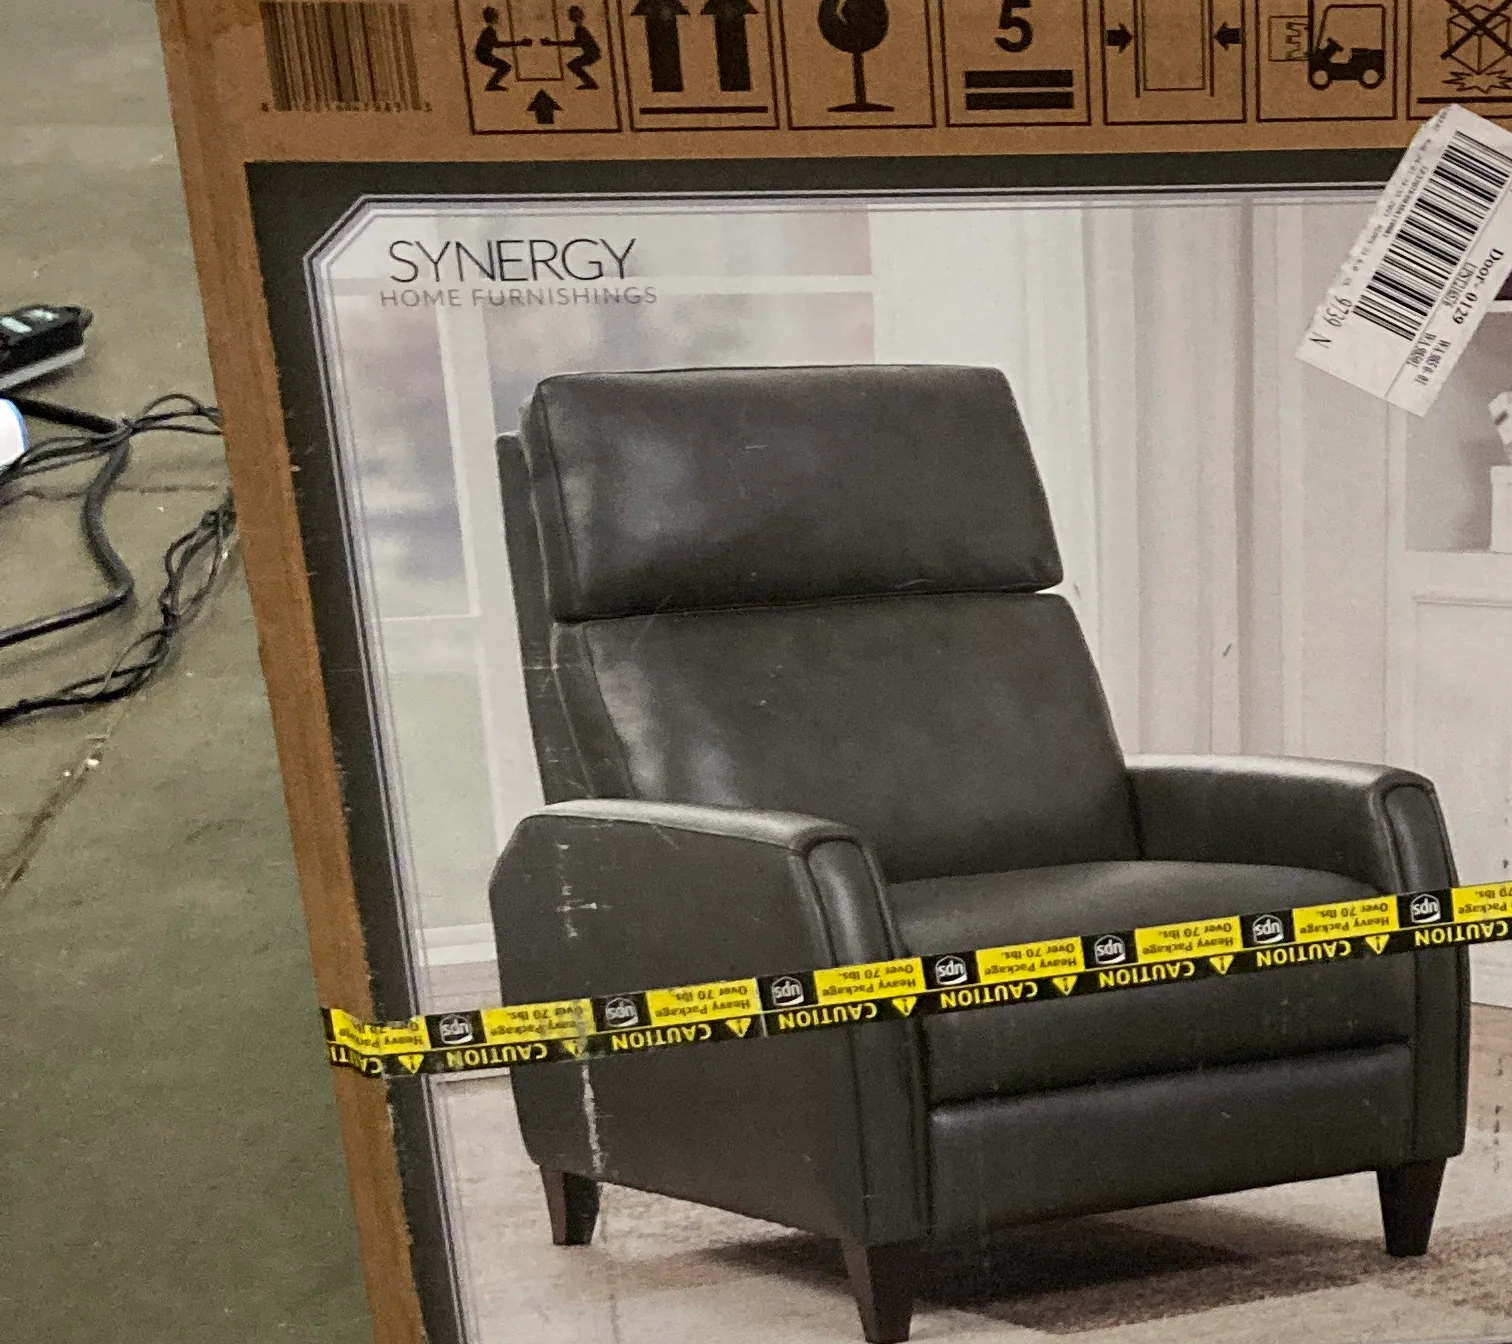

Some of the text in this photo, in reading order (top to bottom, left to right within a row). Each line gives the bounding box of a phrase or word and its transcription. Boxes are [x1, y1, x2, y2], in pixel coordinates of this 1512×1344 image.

[388, 238, 637, 283] SYNERGY
[380, 286, 658, 307] HOME FURNISHINGS
[1453, 290, 1478, 325] 0129
[1416, 921, 1508, 947] CAUTION
[1256, 940, 1351, 967] CAUTION
[1099, 960, 1195, 988] CAUTION
[941, 982, 1038, 1008] CAUTION
